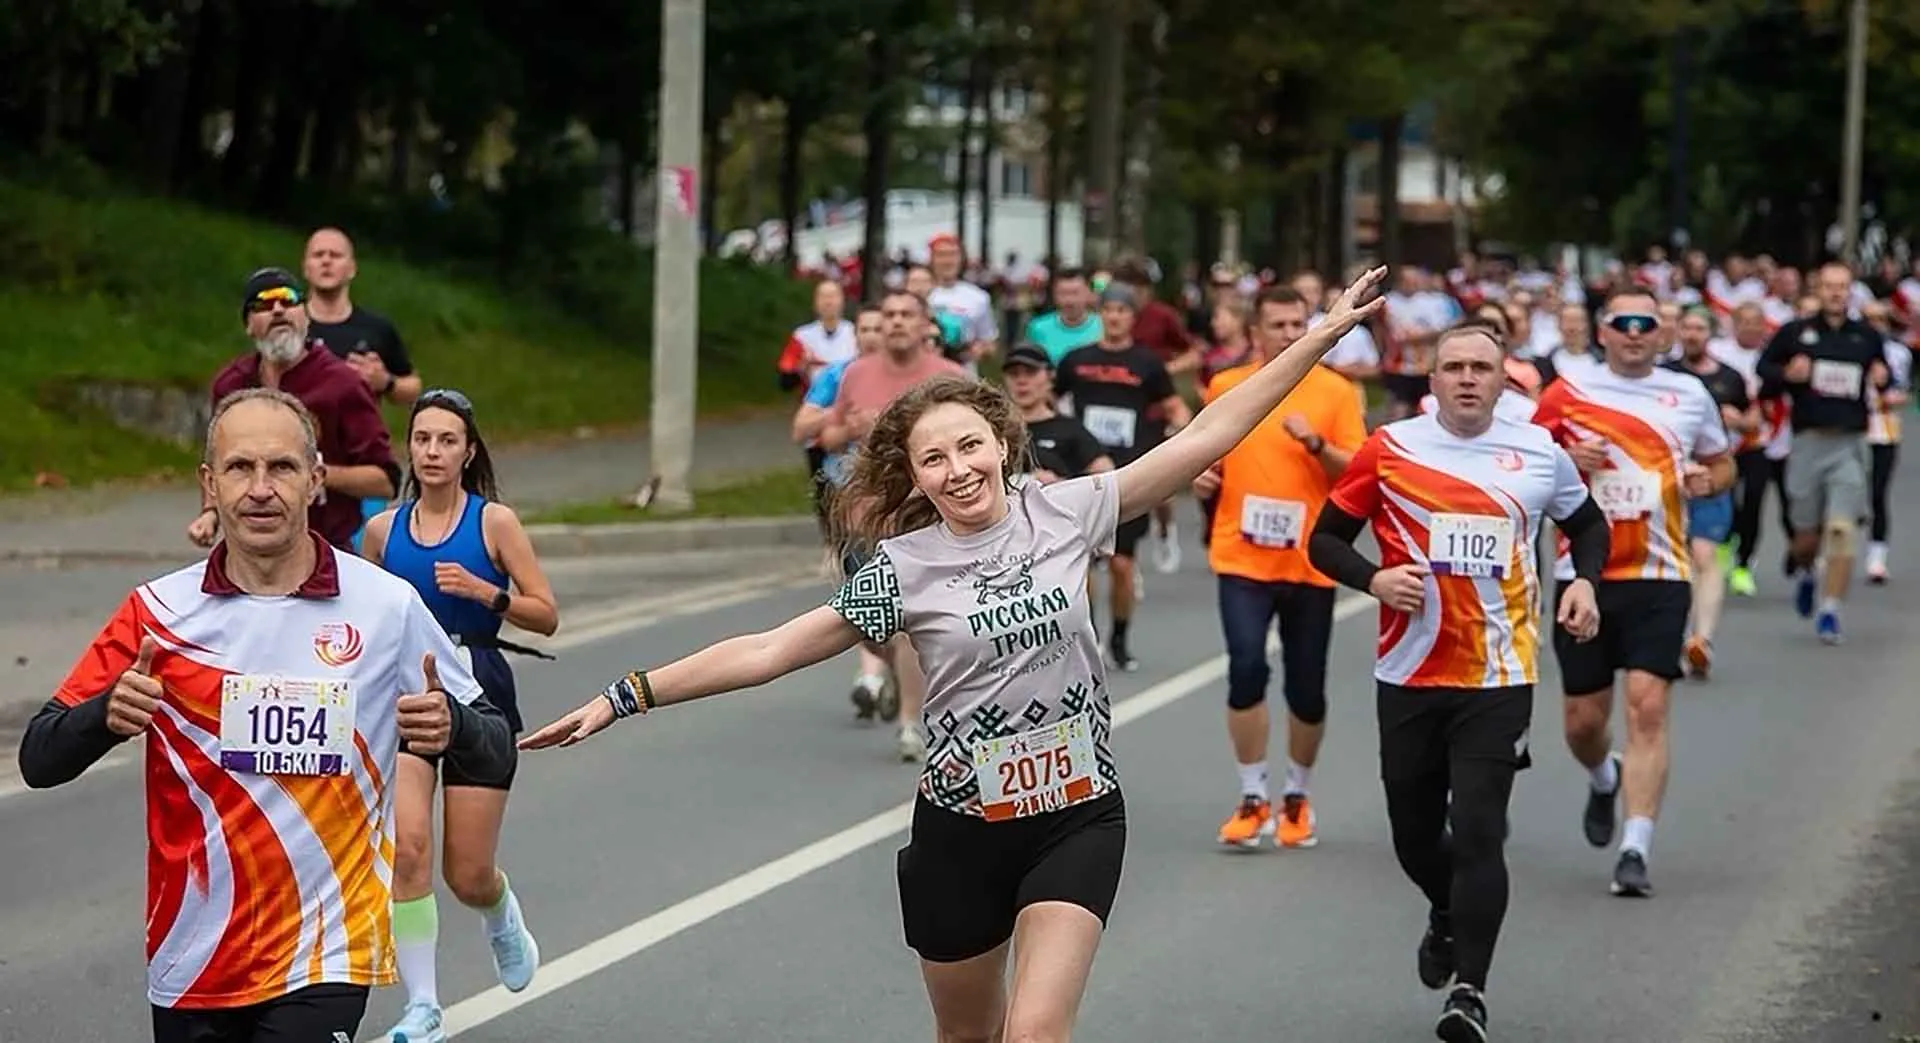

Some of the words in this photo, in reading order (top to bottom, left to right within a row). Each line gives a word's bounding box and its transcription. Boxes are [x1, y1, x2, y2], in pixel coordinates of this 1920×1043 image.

[1447, 532, 1497, 560] 1102
[967, 586, 1070, 637] РУССКАЯ
[989, 618, 1063, 659] ТРОПА
[247, 704, 329, 747] 1054
[252, 752, 322, 775] 10.5KM
[999, 745, 1072, 796] 2075
[1013, 784, 1069, 818] 21.1KM
